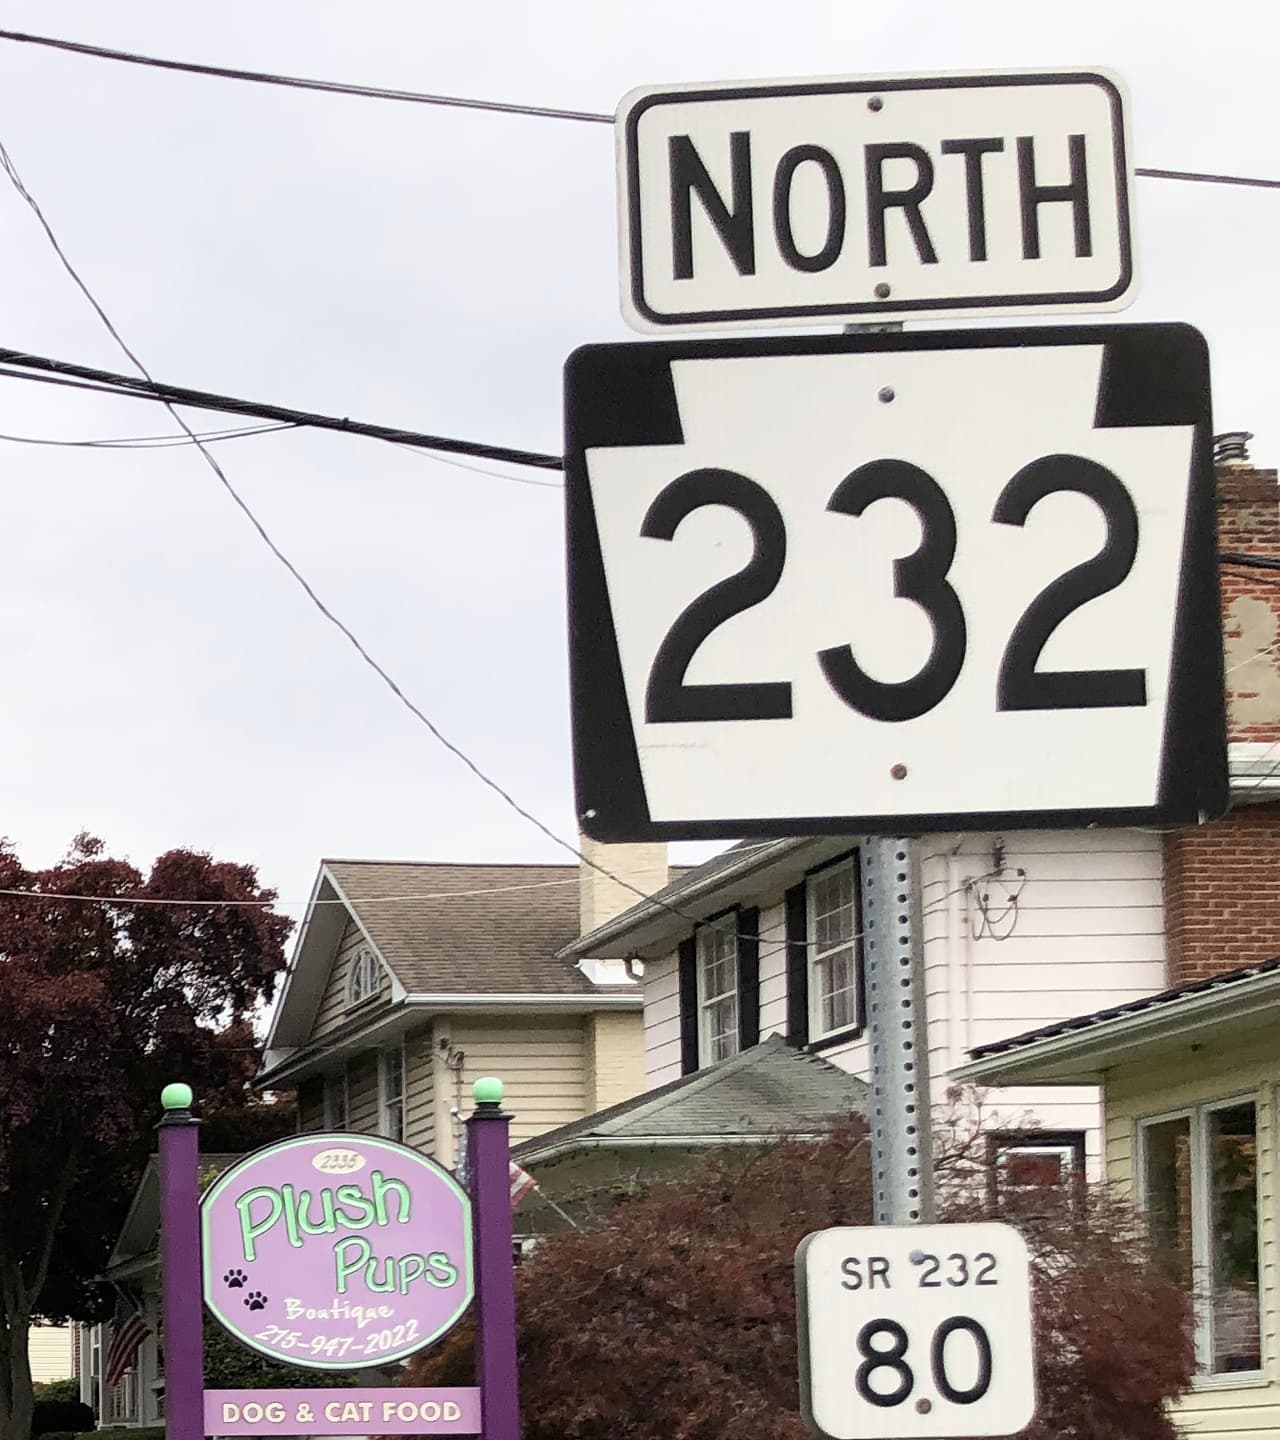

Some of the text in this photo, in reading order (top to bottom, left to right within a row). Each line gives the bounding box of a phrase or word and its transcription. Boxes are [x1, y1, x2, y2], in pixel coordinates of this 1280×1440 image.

[668, 130, 1094, 282] NORTH
[639, 453, 1148, 724] 232
[236, 1169, 412, 1262] Plush
[333, 1235, 458, 1294] Pups
[840, 1252, 999, 1291] SR 232
[255, 1319, 420, 1357] 215-947-2022
[284, 1298, 394, 1328] Boutique
[854, 1315, 993, 1408] 80
[222, 1401, 462, 1424] DOG & CAT FOOD
